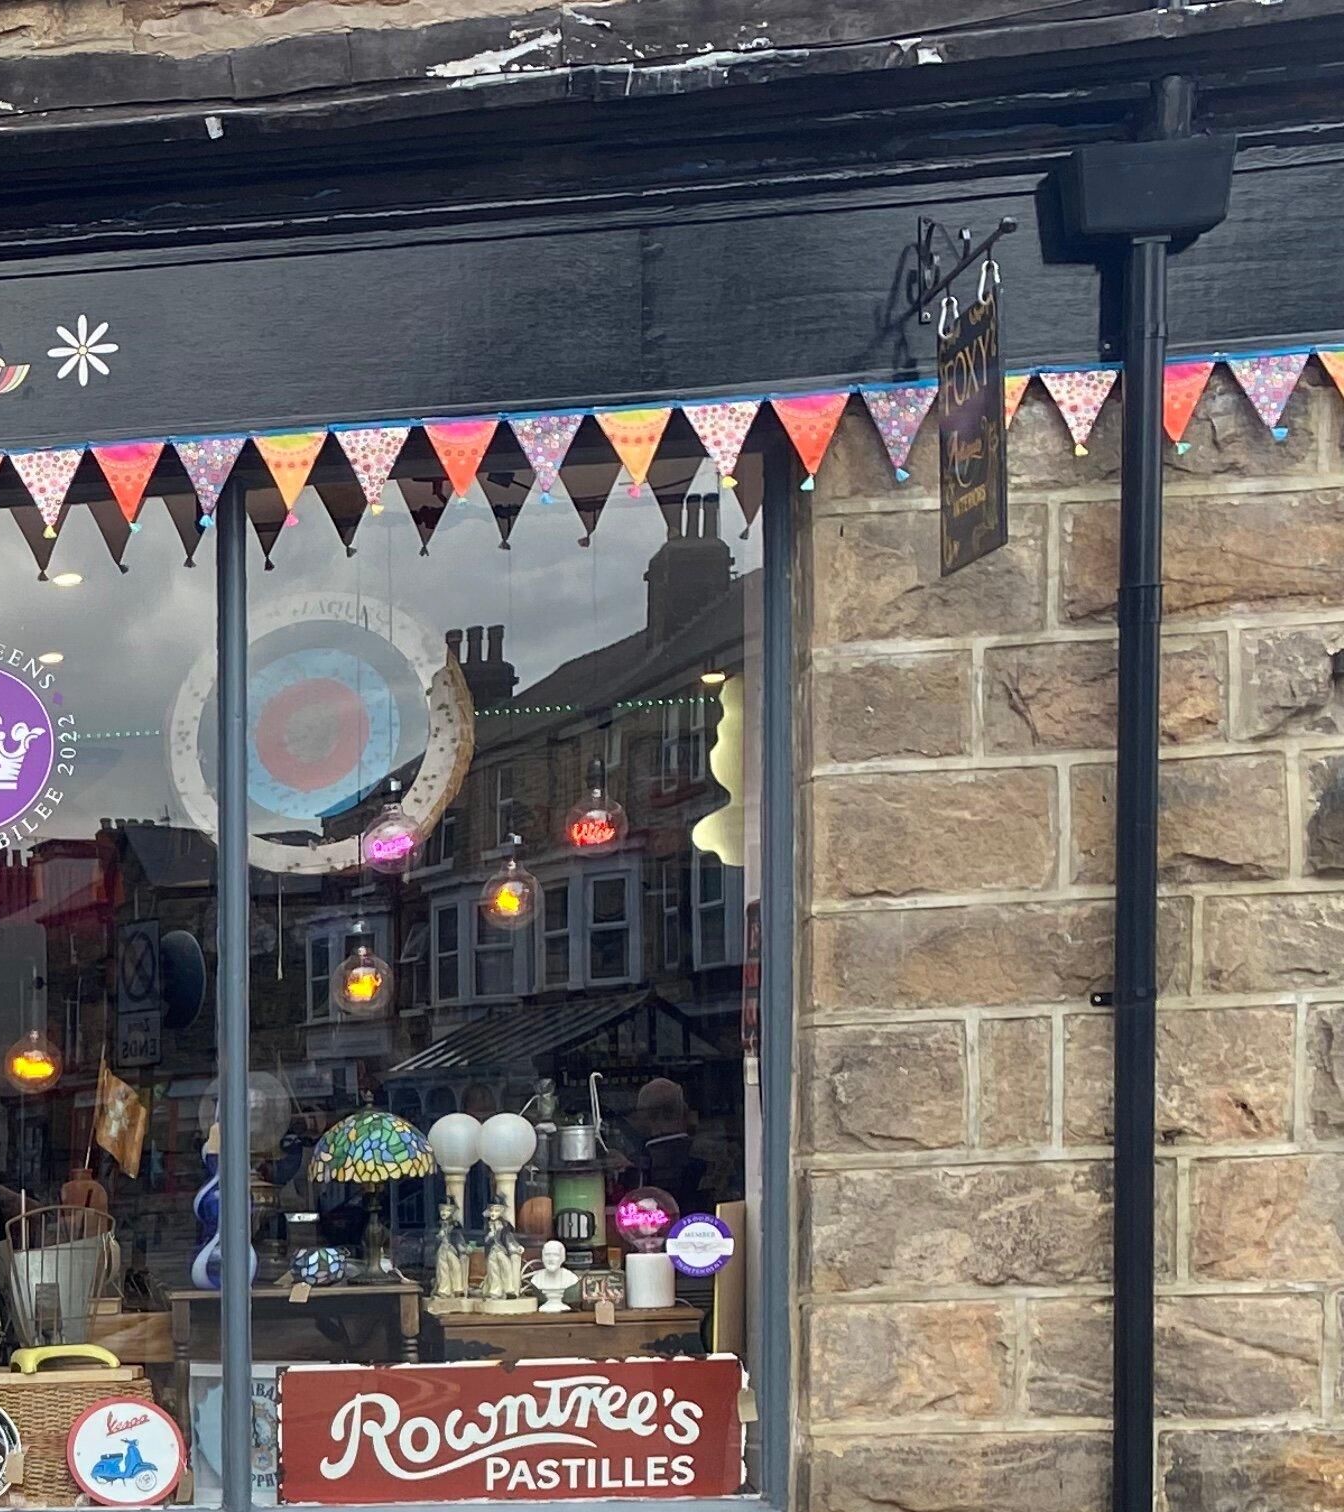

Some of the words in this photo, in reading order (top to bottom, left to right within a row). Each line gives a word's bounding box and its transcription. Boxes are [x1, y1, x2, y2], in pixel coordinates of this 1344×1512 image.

[57, 713, 78, 776] 2022
[106, 1411, 150, 1436] Vespa
[320, 1375, 703, 1480] Rowntree's
[485, 1455, 696, 1492] PASTILLES
